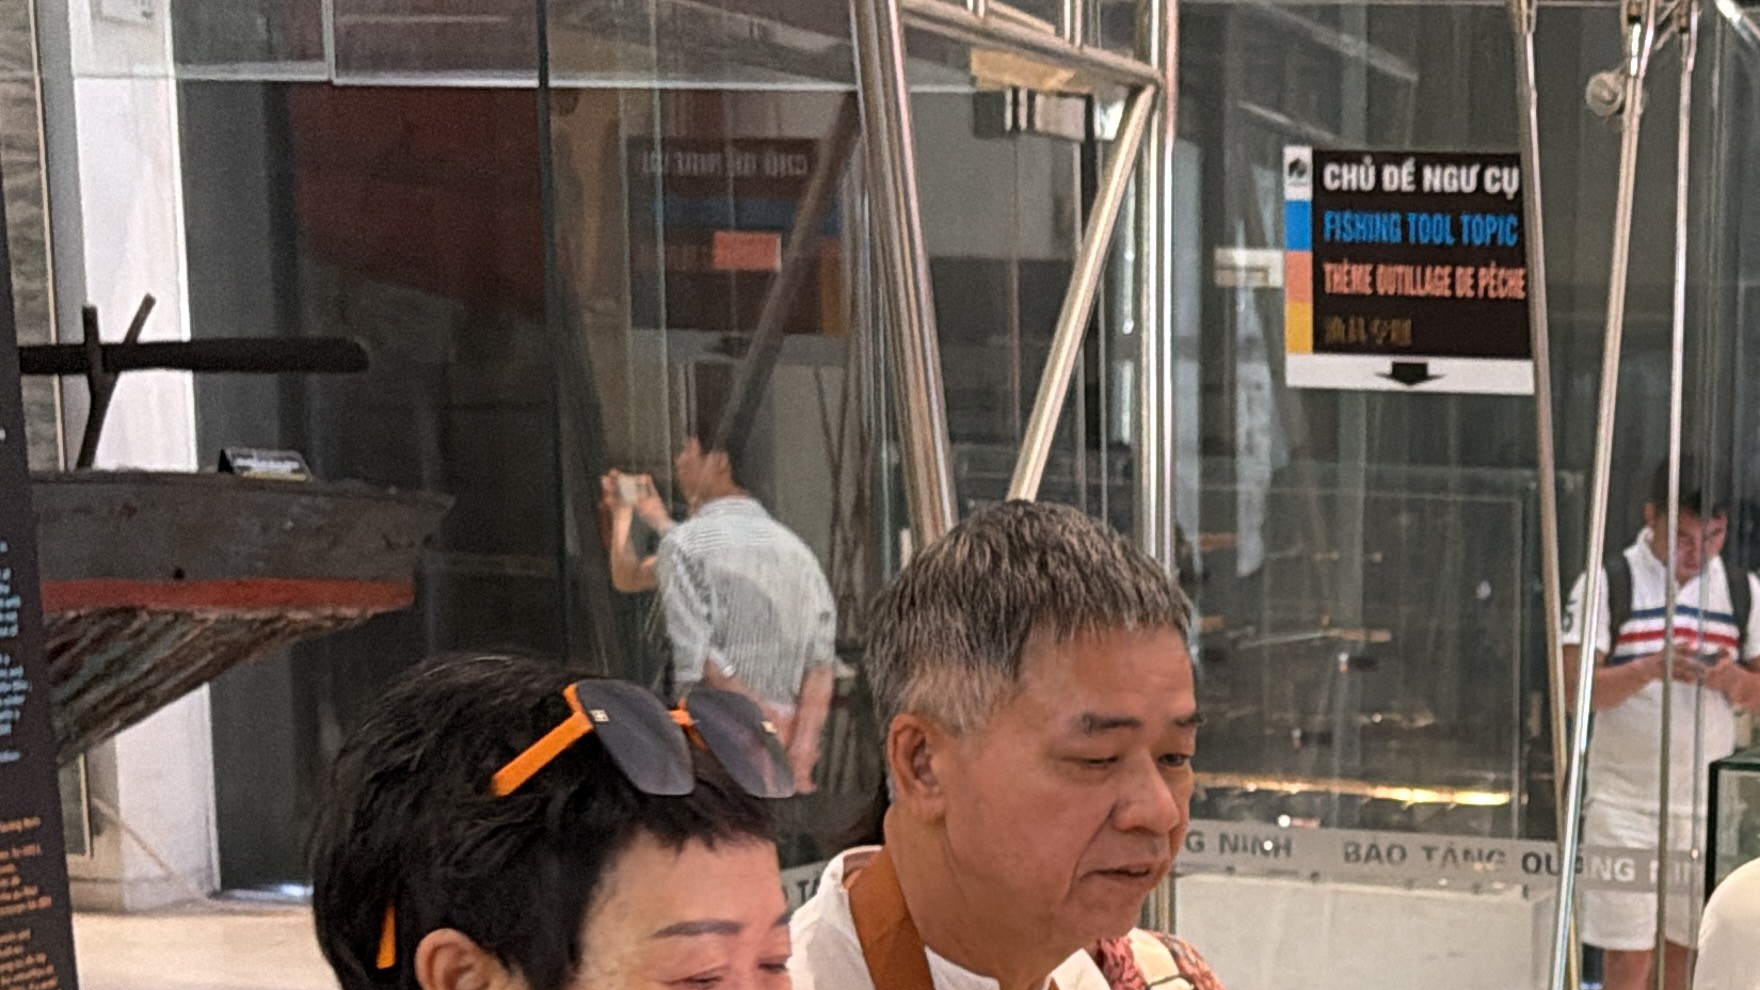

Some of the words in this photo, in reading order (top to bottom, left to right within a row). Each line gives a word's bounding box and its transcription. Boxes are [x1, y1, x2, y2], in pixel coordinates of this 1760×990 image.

[1323, 154, 1376, 192] CHỦ
[1422, 163, 1481, 194] NGƯ
[1483, 165, 1520, 200] CỤ
[1323, 210, 1402, 243] FISHING
[1408, 212, 1455, 245] TOOL
[1460, 213, 1519, 247] TOPIC
[1376, 264, 1452, 297] OUTILLAGE
[1455, 266, 1475, 298] DE
[1520, 851, 1636, 882] QUNG
